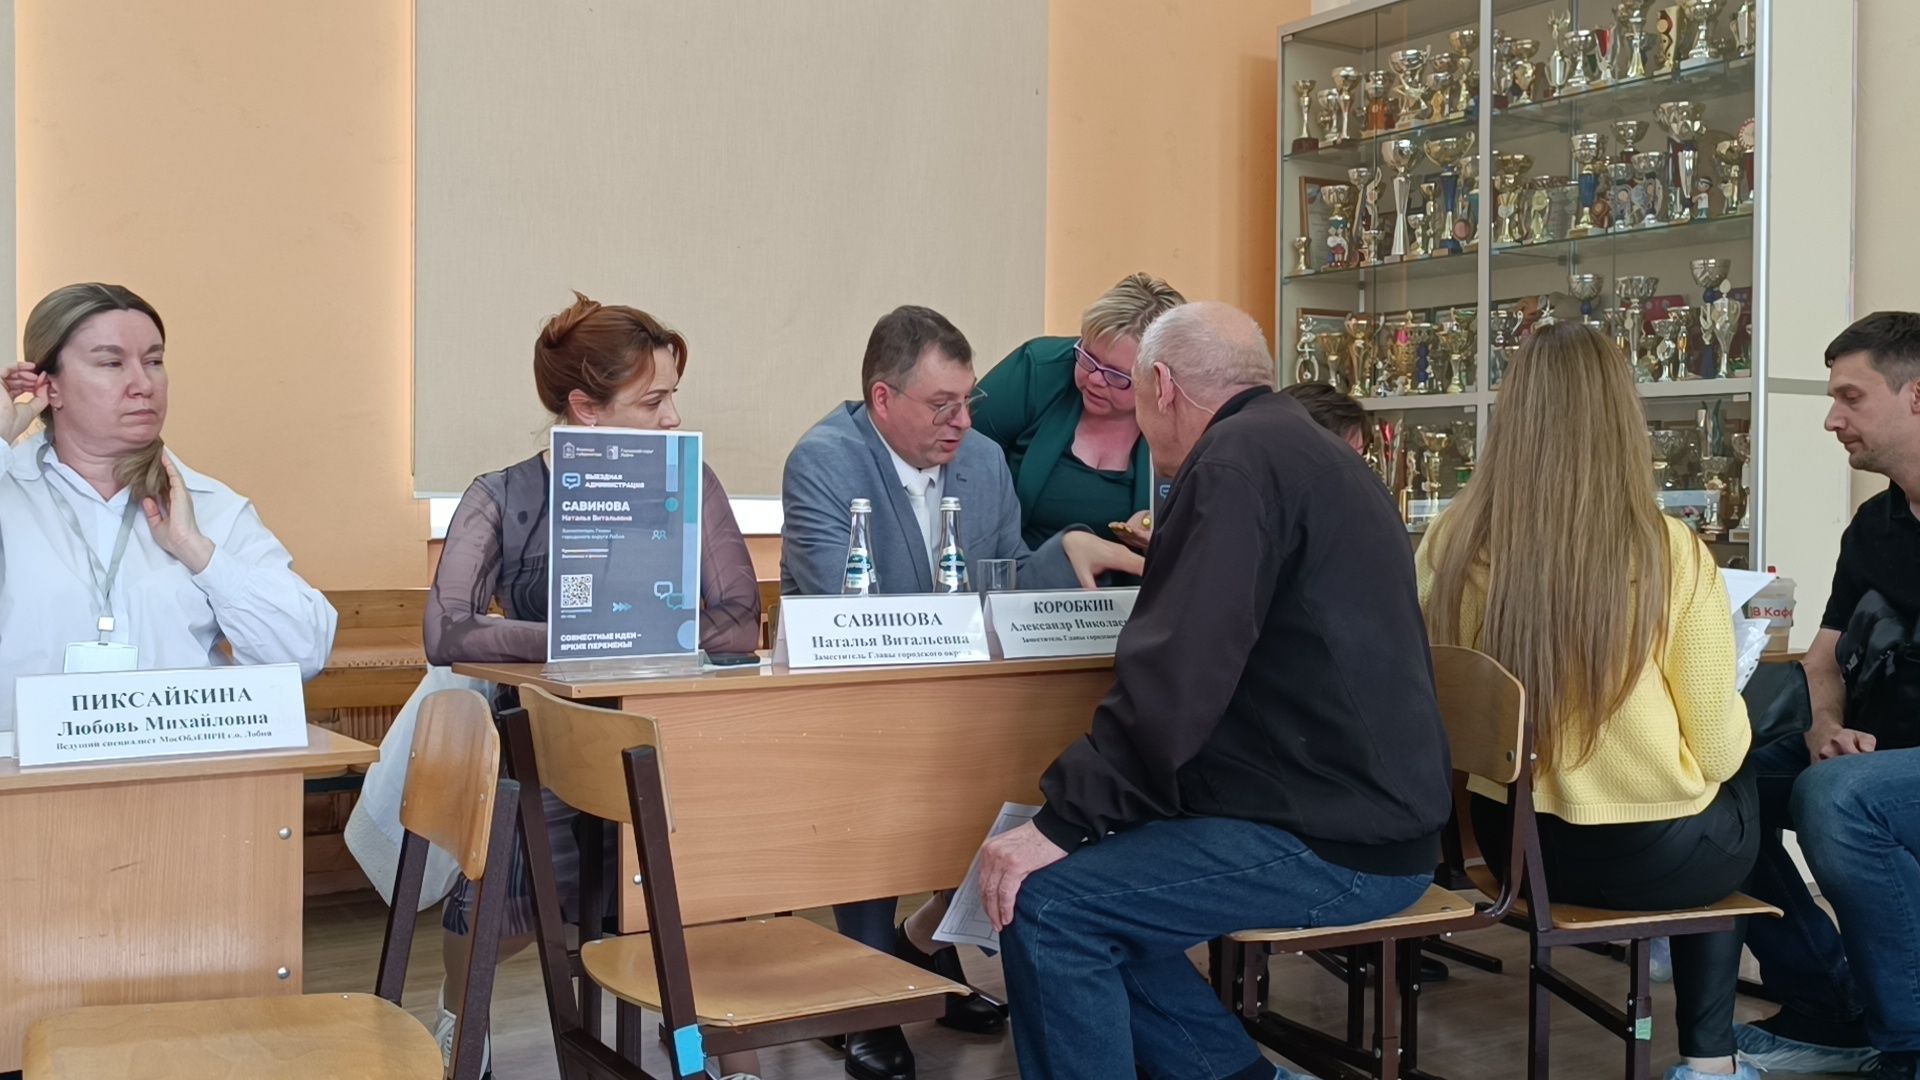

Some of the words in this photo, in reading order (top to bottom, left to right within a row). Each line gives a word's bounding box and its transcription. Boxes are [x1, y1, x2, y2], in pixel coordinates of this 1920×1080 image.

[562, 501, 630, 511] САВИНОВА
[1034, 599, 1114, 614] КОРОБКИН
[833, 612, 943, 628] САВИНОВА
[1010, 621, 1073, 633] Александр
[1075, 618, 1127, 630] Николае
[560, 633, 613, 641] СОВМЕСТНЫЕ
[614, 632, 637, 640] ИДЕИ
[811, 635, 878, 649] Наталья
[882, 633, 970, 647] Витальевна
[814, 652, 866, 660] Заместитель
[868, 651, 896, 659] Главы
[72, 686, 252, 712] ПИКСАЙКИНА
[57, 719, 139, 737] Любовь
[145, 712, 269, 731] Михайловна
